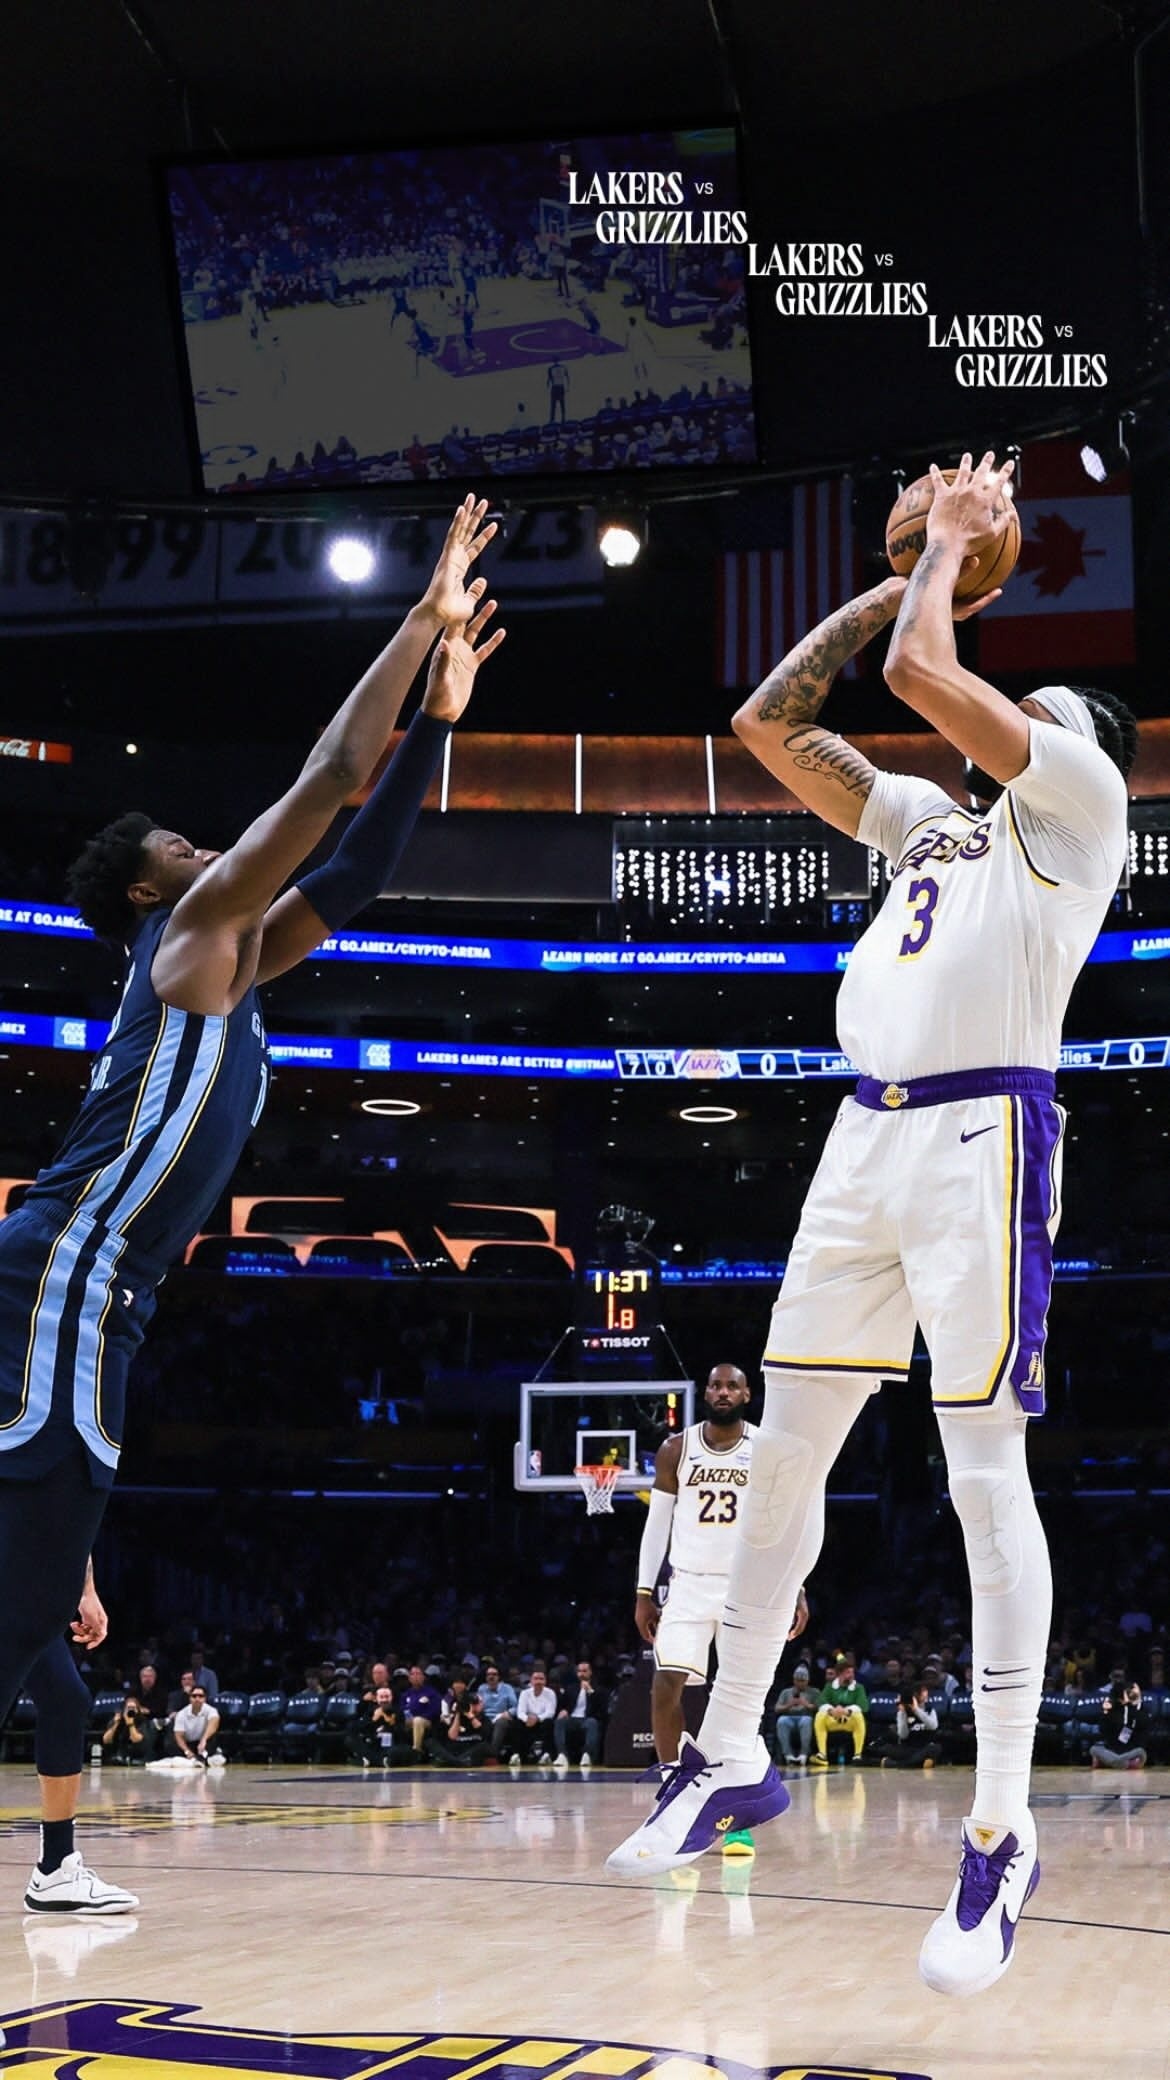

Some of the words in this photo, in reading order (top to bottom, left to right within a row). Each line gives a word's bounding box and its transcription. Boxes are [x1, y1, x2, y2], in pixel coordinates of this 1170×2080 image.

[897, 877, 940, 962] 3
[543, 950, 581, 962] LEARN
[584, 951, 618, 964] MORE
[620, 951, 635, 964] AT
[417, 1052, 458, 1064] LAKERS
[461, 1054, 498, 1066] GAMES
[500, 1056, 521, 1067] ARE
[524, 1057, 563, 1069] BETTER
[760, 1053, 776, 1075] 0
[1128, 1042, 1145, 1065] 0
[629, 1060, 640, 1076] 7
[595, 1269, 648, 1293] 11:37
[607, 1293, 635, 1330] 1.8
[600, 1336, 651, 1348] TISSOT
[686, 1464, 749, 1487] LAKERS
[698, 1490, 737, 1524] 23
